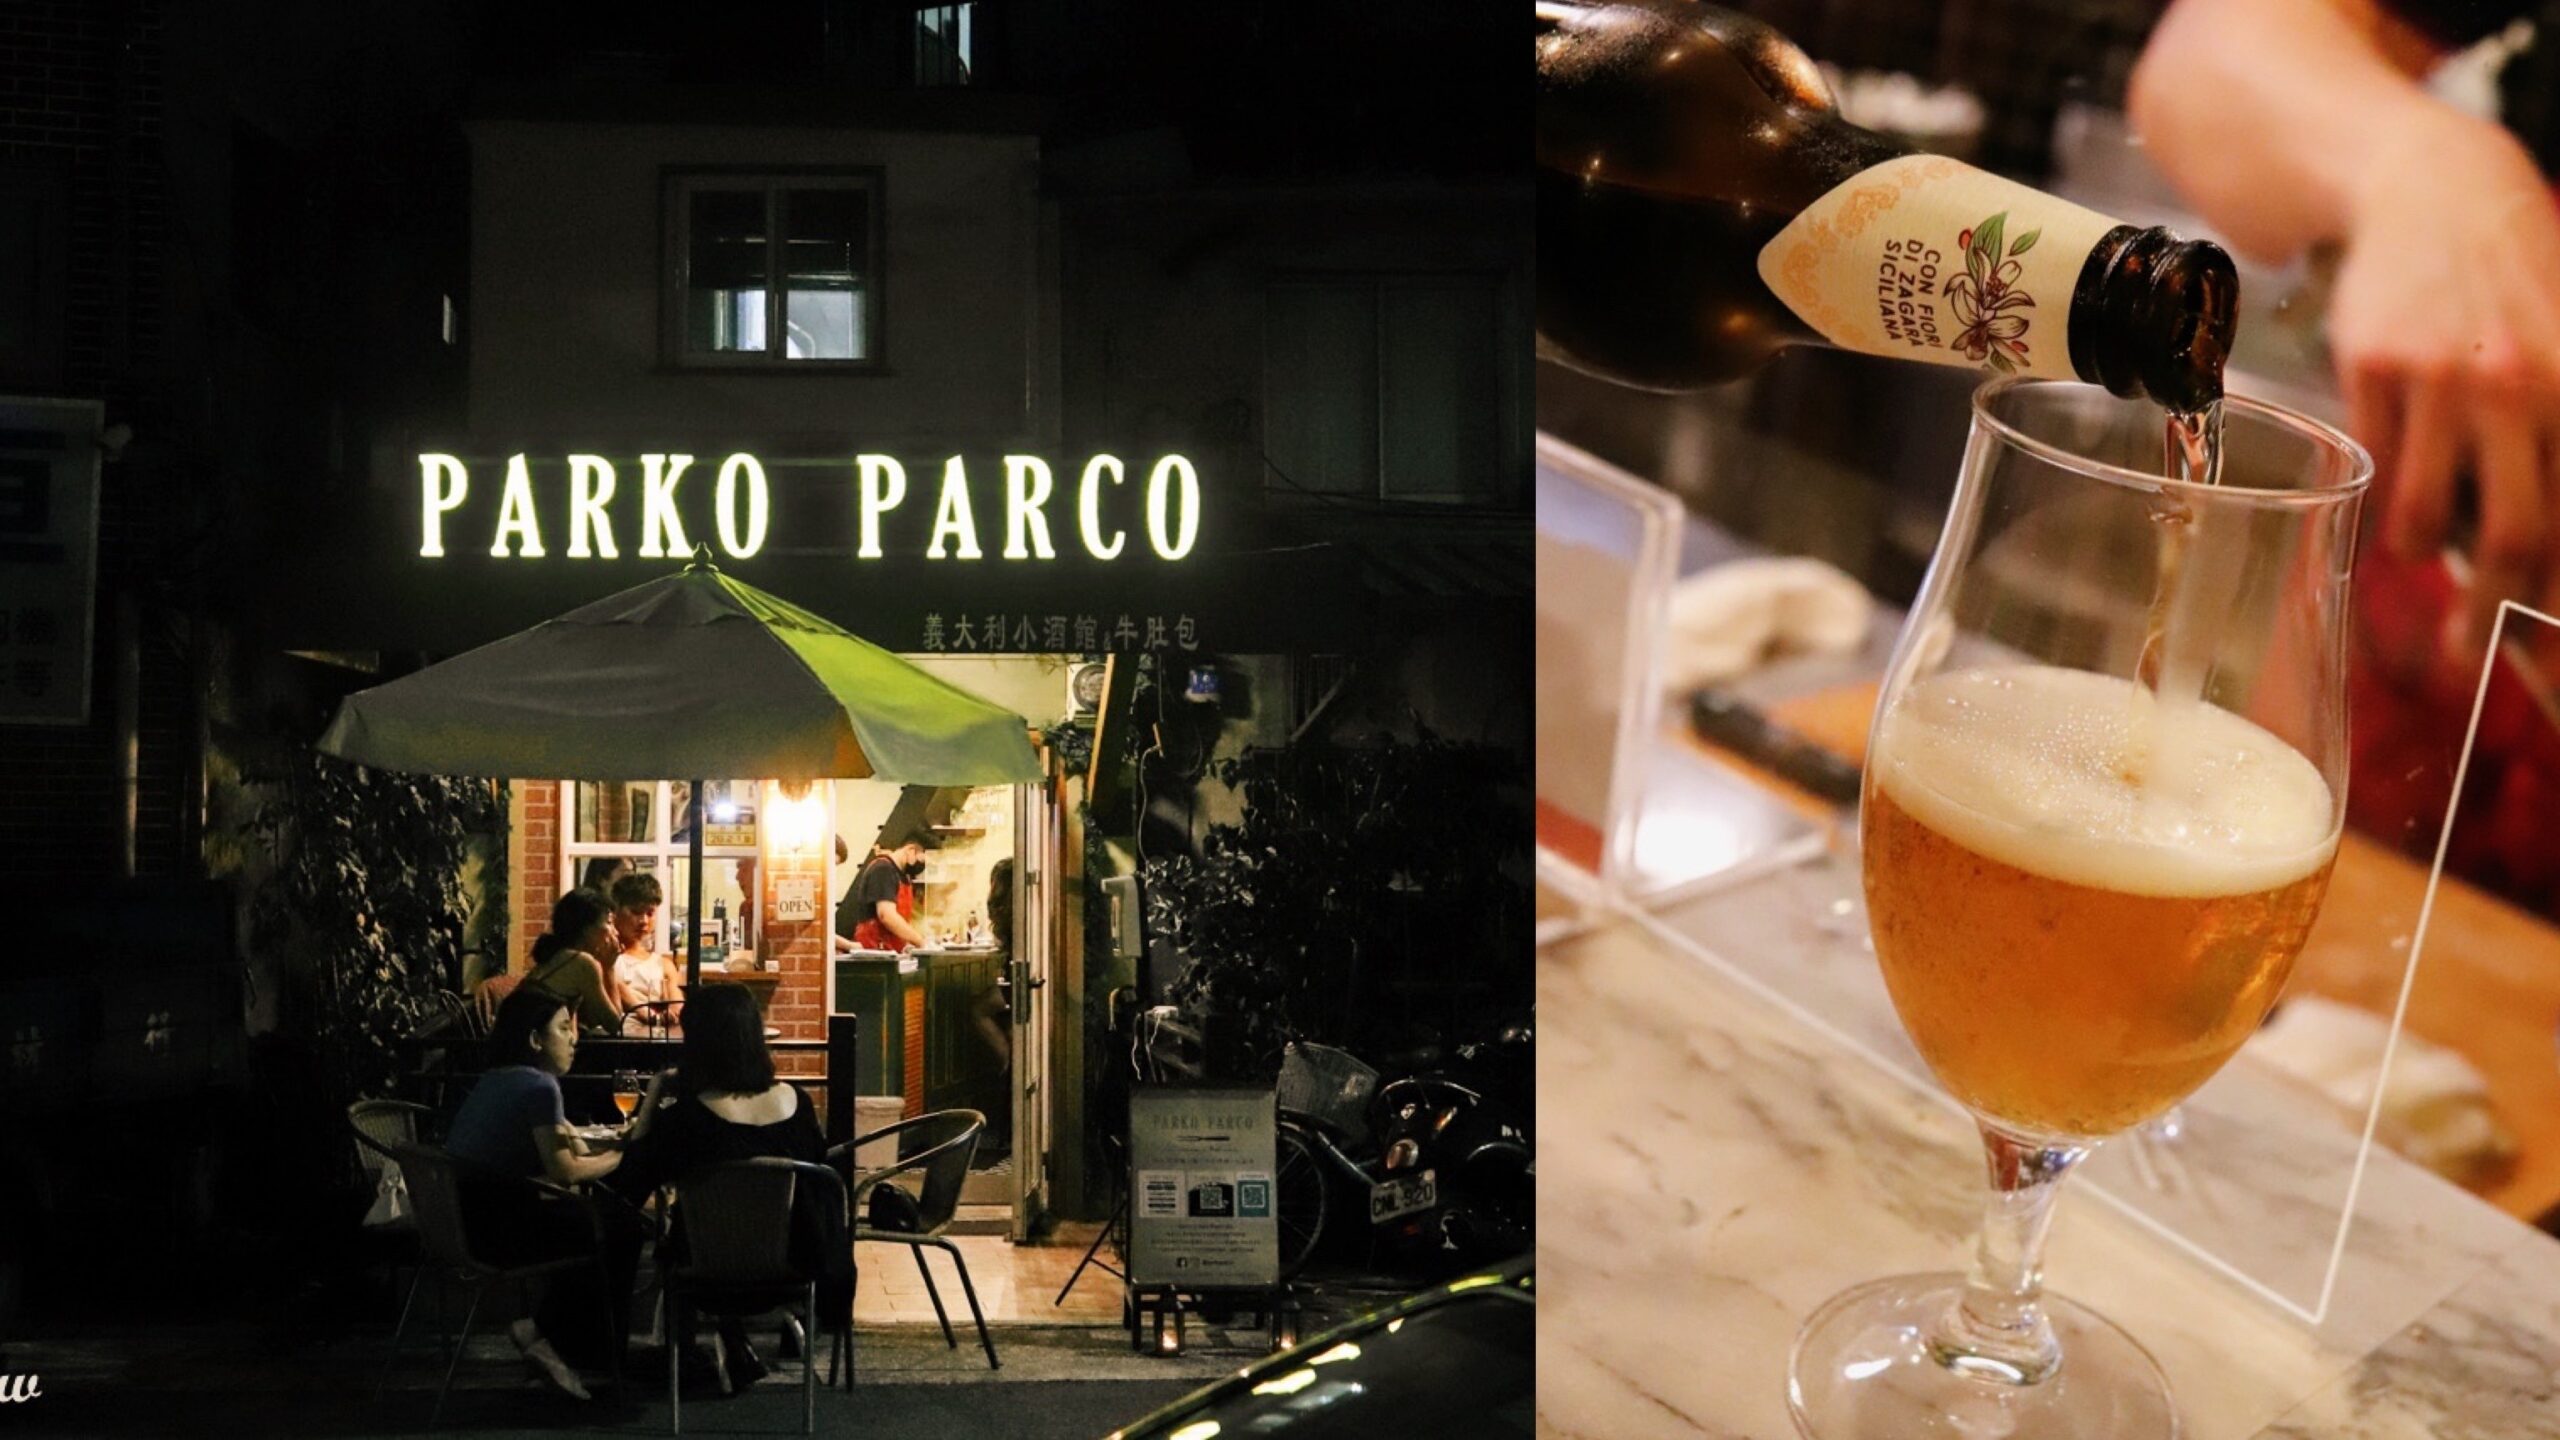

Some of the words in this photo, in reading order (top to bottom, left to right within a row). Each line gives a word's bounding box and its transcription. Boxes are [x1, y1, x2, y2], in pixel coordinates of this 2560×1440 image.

[1903, 239, 1924, 262] DI
[1918, 249, 1942, 295] CON
[1878, 239, 1903, 340] SICILIANA
[1898, 271, 1924, 347] ZAGARA
[1917, 303, 1944, 348] FIORI
[419, 452, 770, 559] PARKO
[857, 452, 1202, 560] PARCO
[779, 899, 813, 914] OPEN
